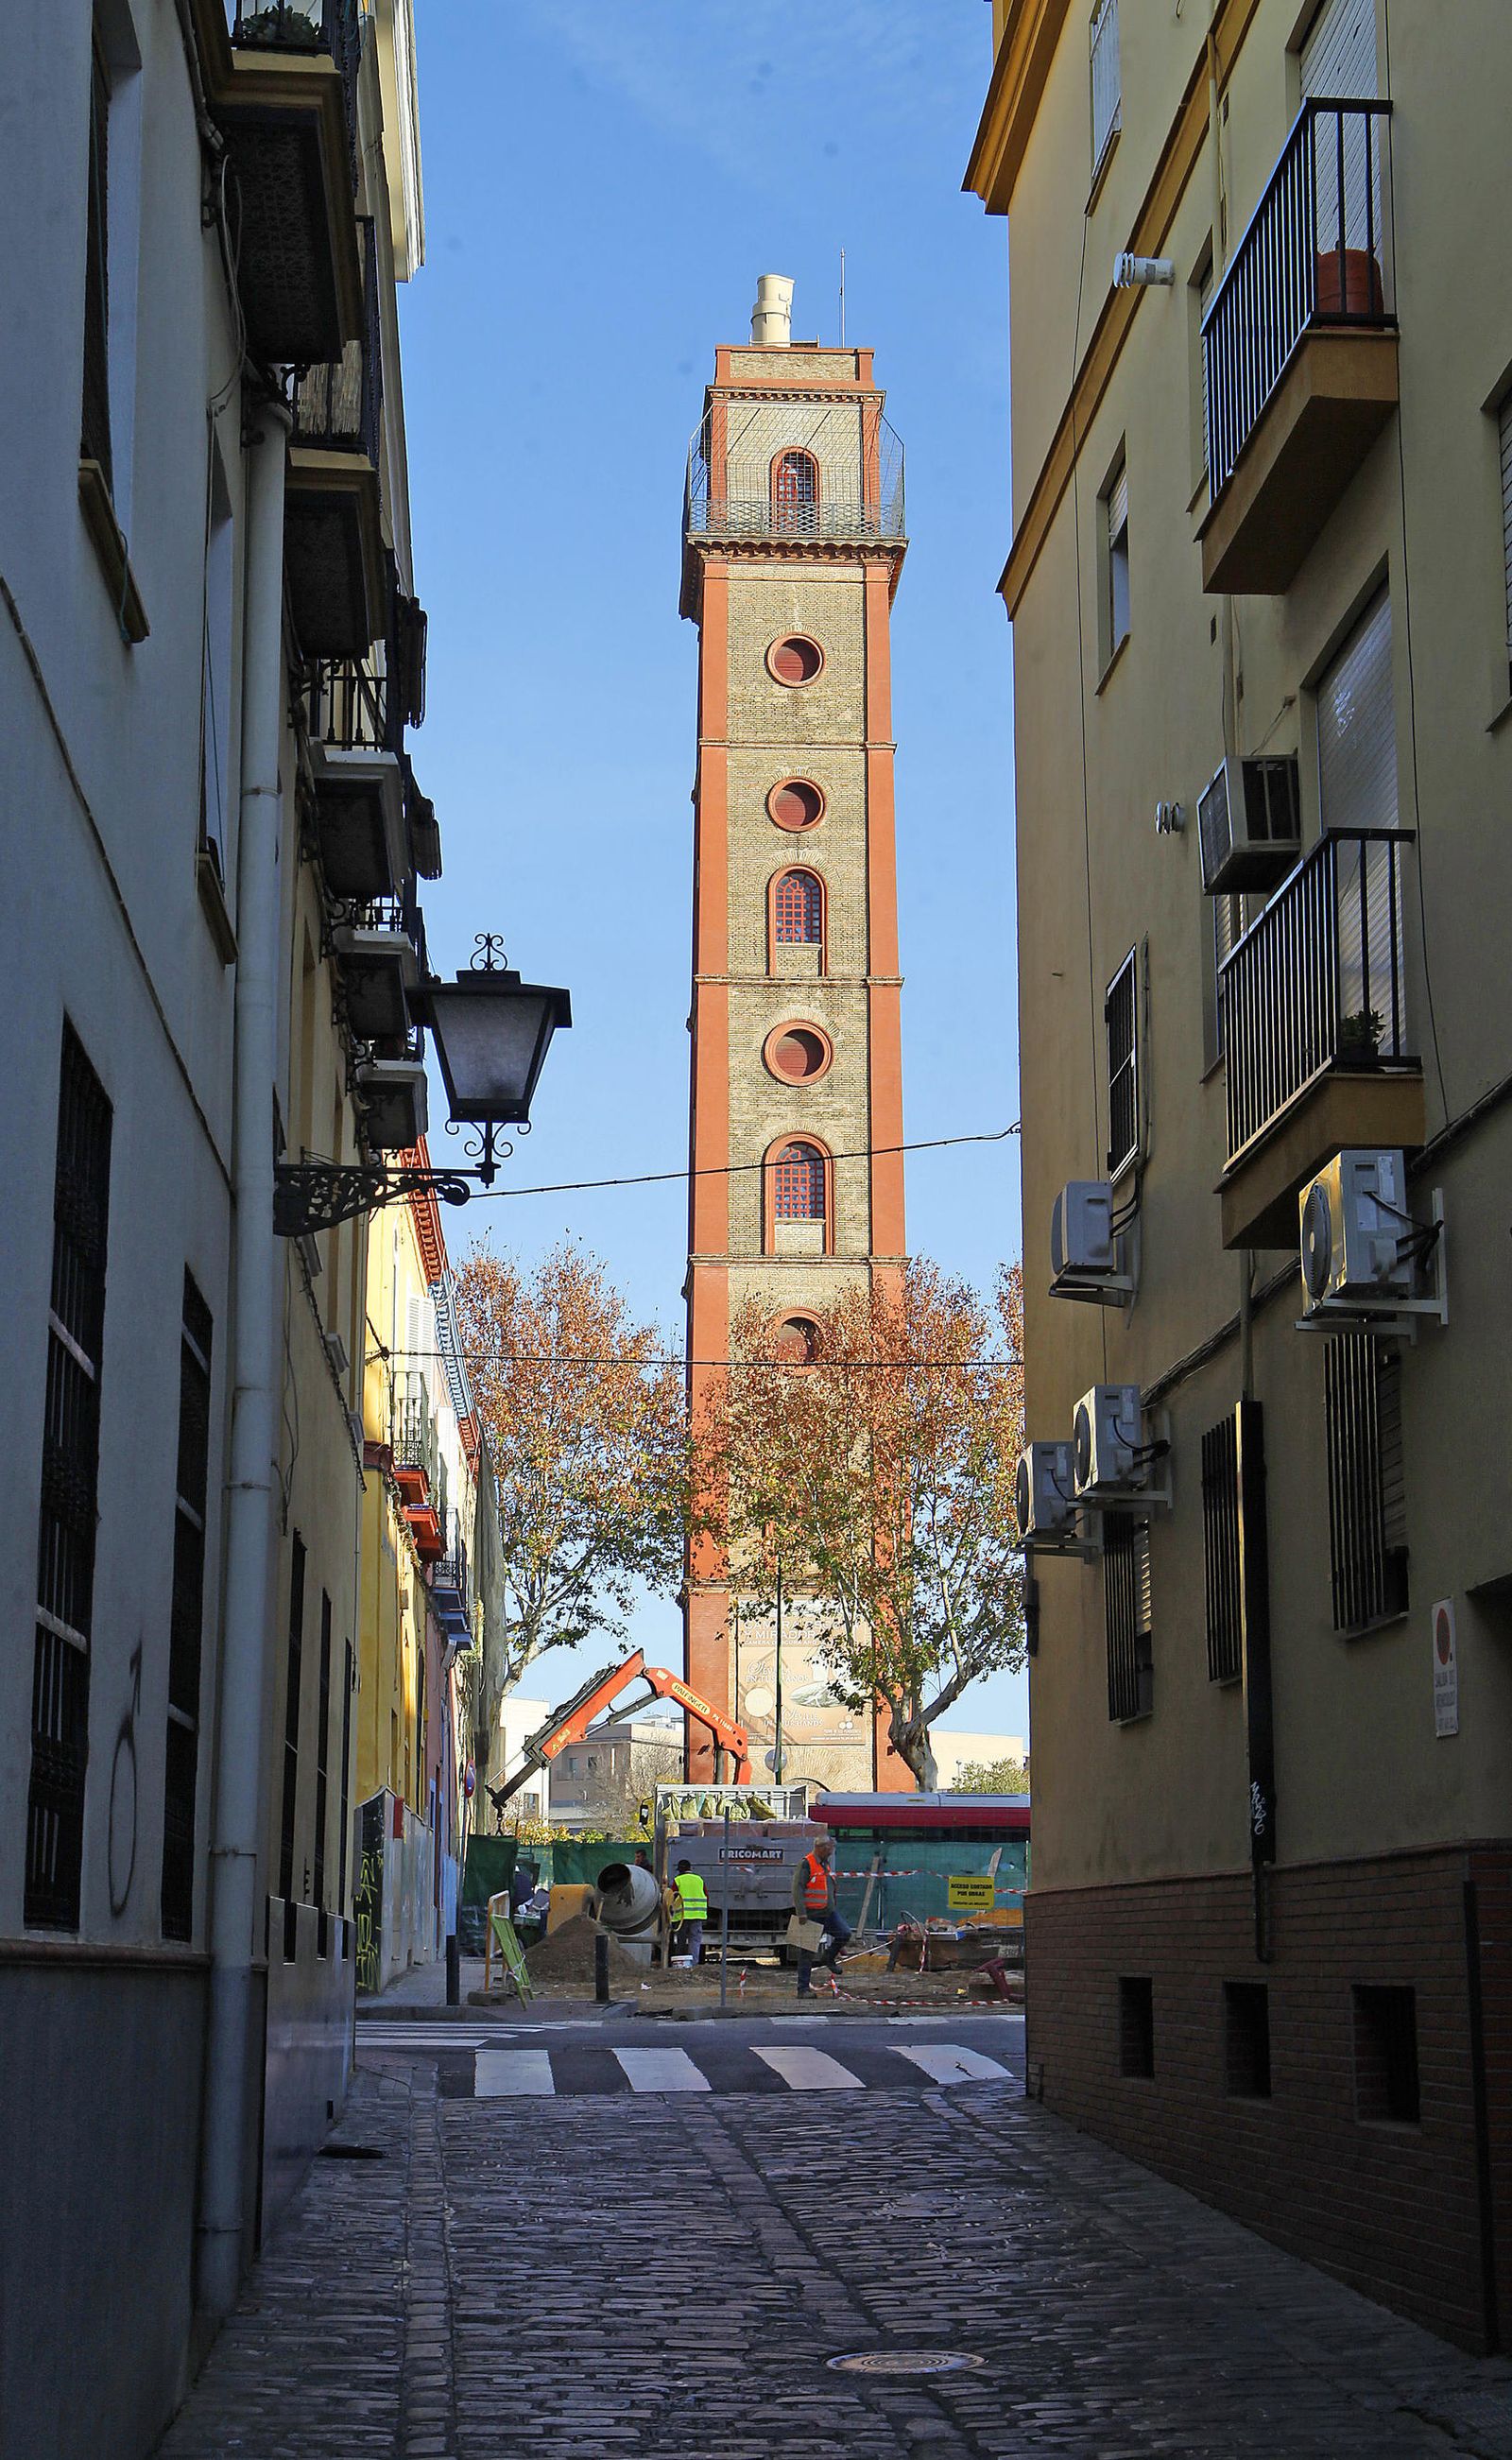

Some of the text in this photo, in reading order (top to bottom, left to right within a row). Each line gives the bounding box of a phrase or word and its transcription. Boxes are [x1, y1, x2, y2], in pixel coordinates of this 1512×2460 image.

[744, 1620, 804, 1629] CAMRA
[755, 1630, 816, 1639] MIRADOR
[674, 1684, 708, 1713] PALFINGER
